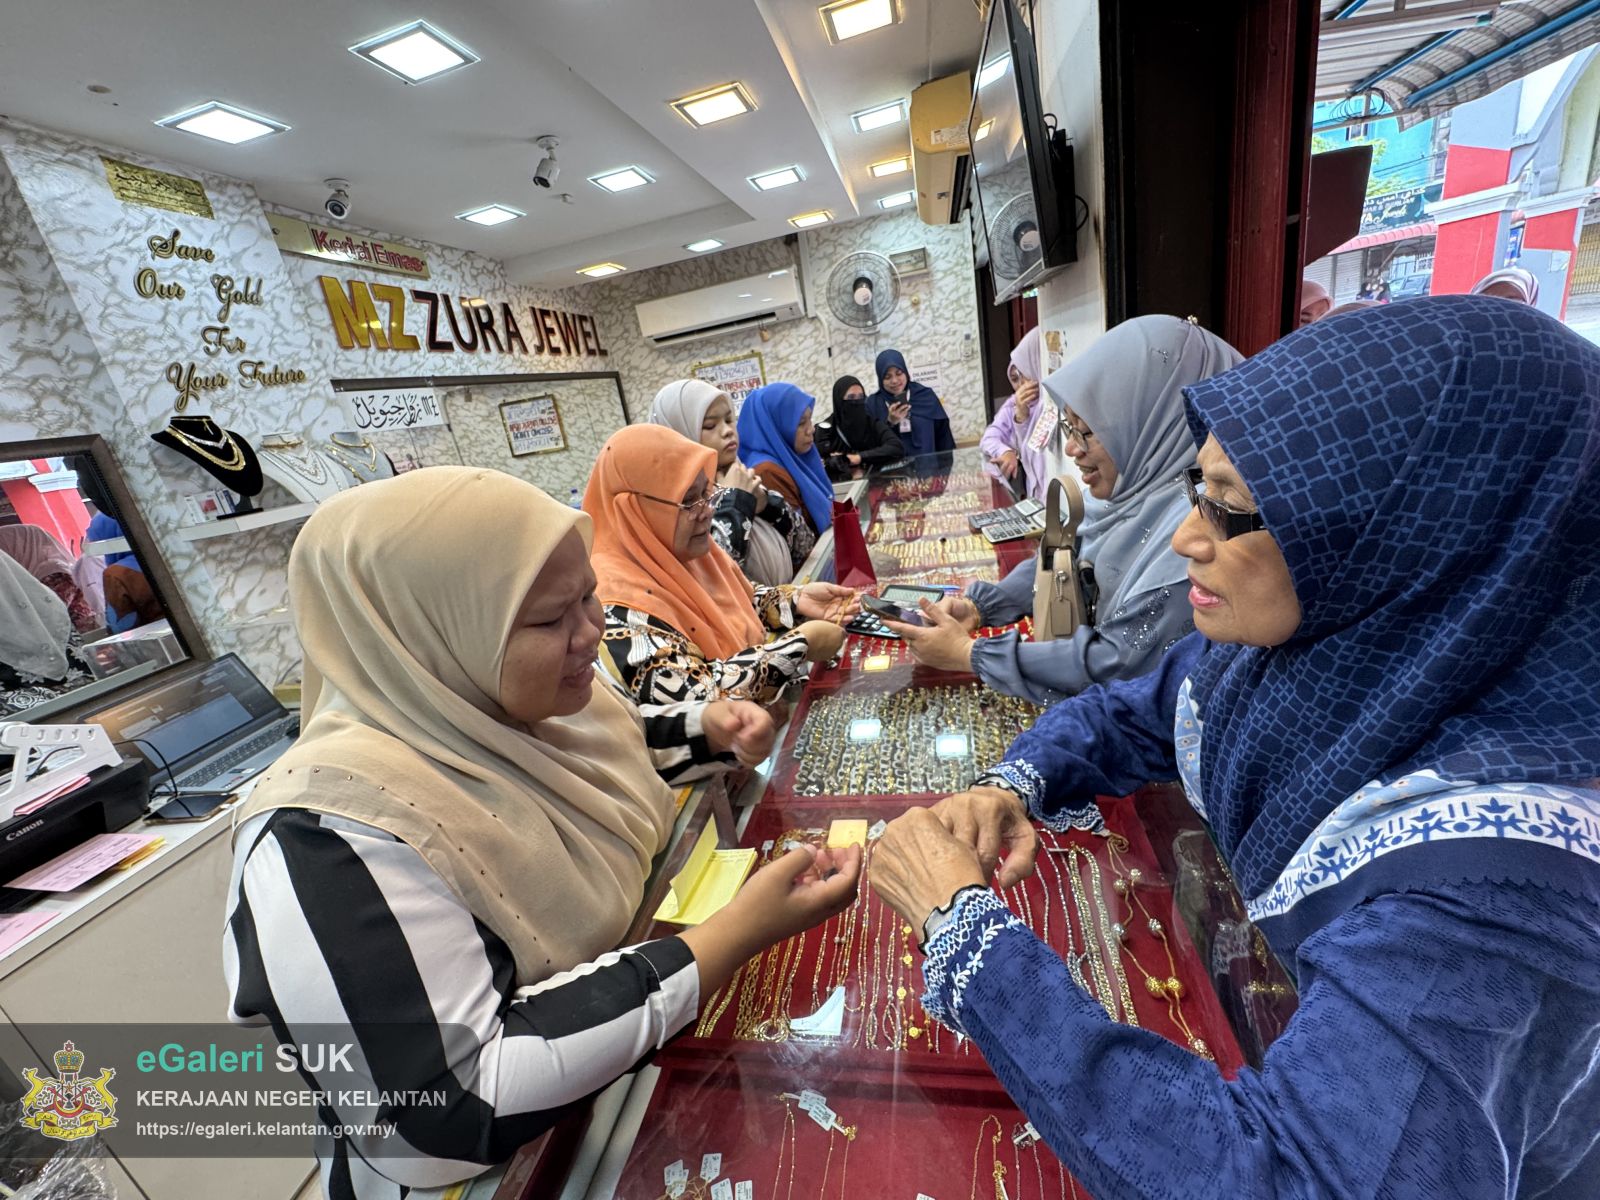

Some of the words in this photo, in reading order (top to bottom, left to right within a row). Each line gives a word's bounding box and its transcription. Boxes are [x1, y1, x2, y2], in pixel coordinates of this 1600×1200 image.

[147, 229, 215, 263] Save
[311, 228, 372, 263] Kedai
[370, 241, 423, 273] Emas
[133, 268, 185, 300] Our
[210, 273, 264, 323] Gold
[318, 276, 421, 351] MZ
[410, 289, 530, 353] ZURA
[529, 306, 608, 357] JEWEL
[166, 361, 229, 413] Your
[238, 360, 306, 388] Future
[6, 818, 44, 841] Canon
